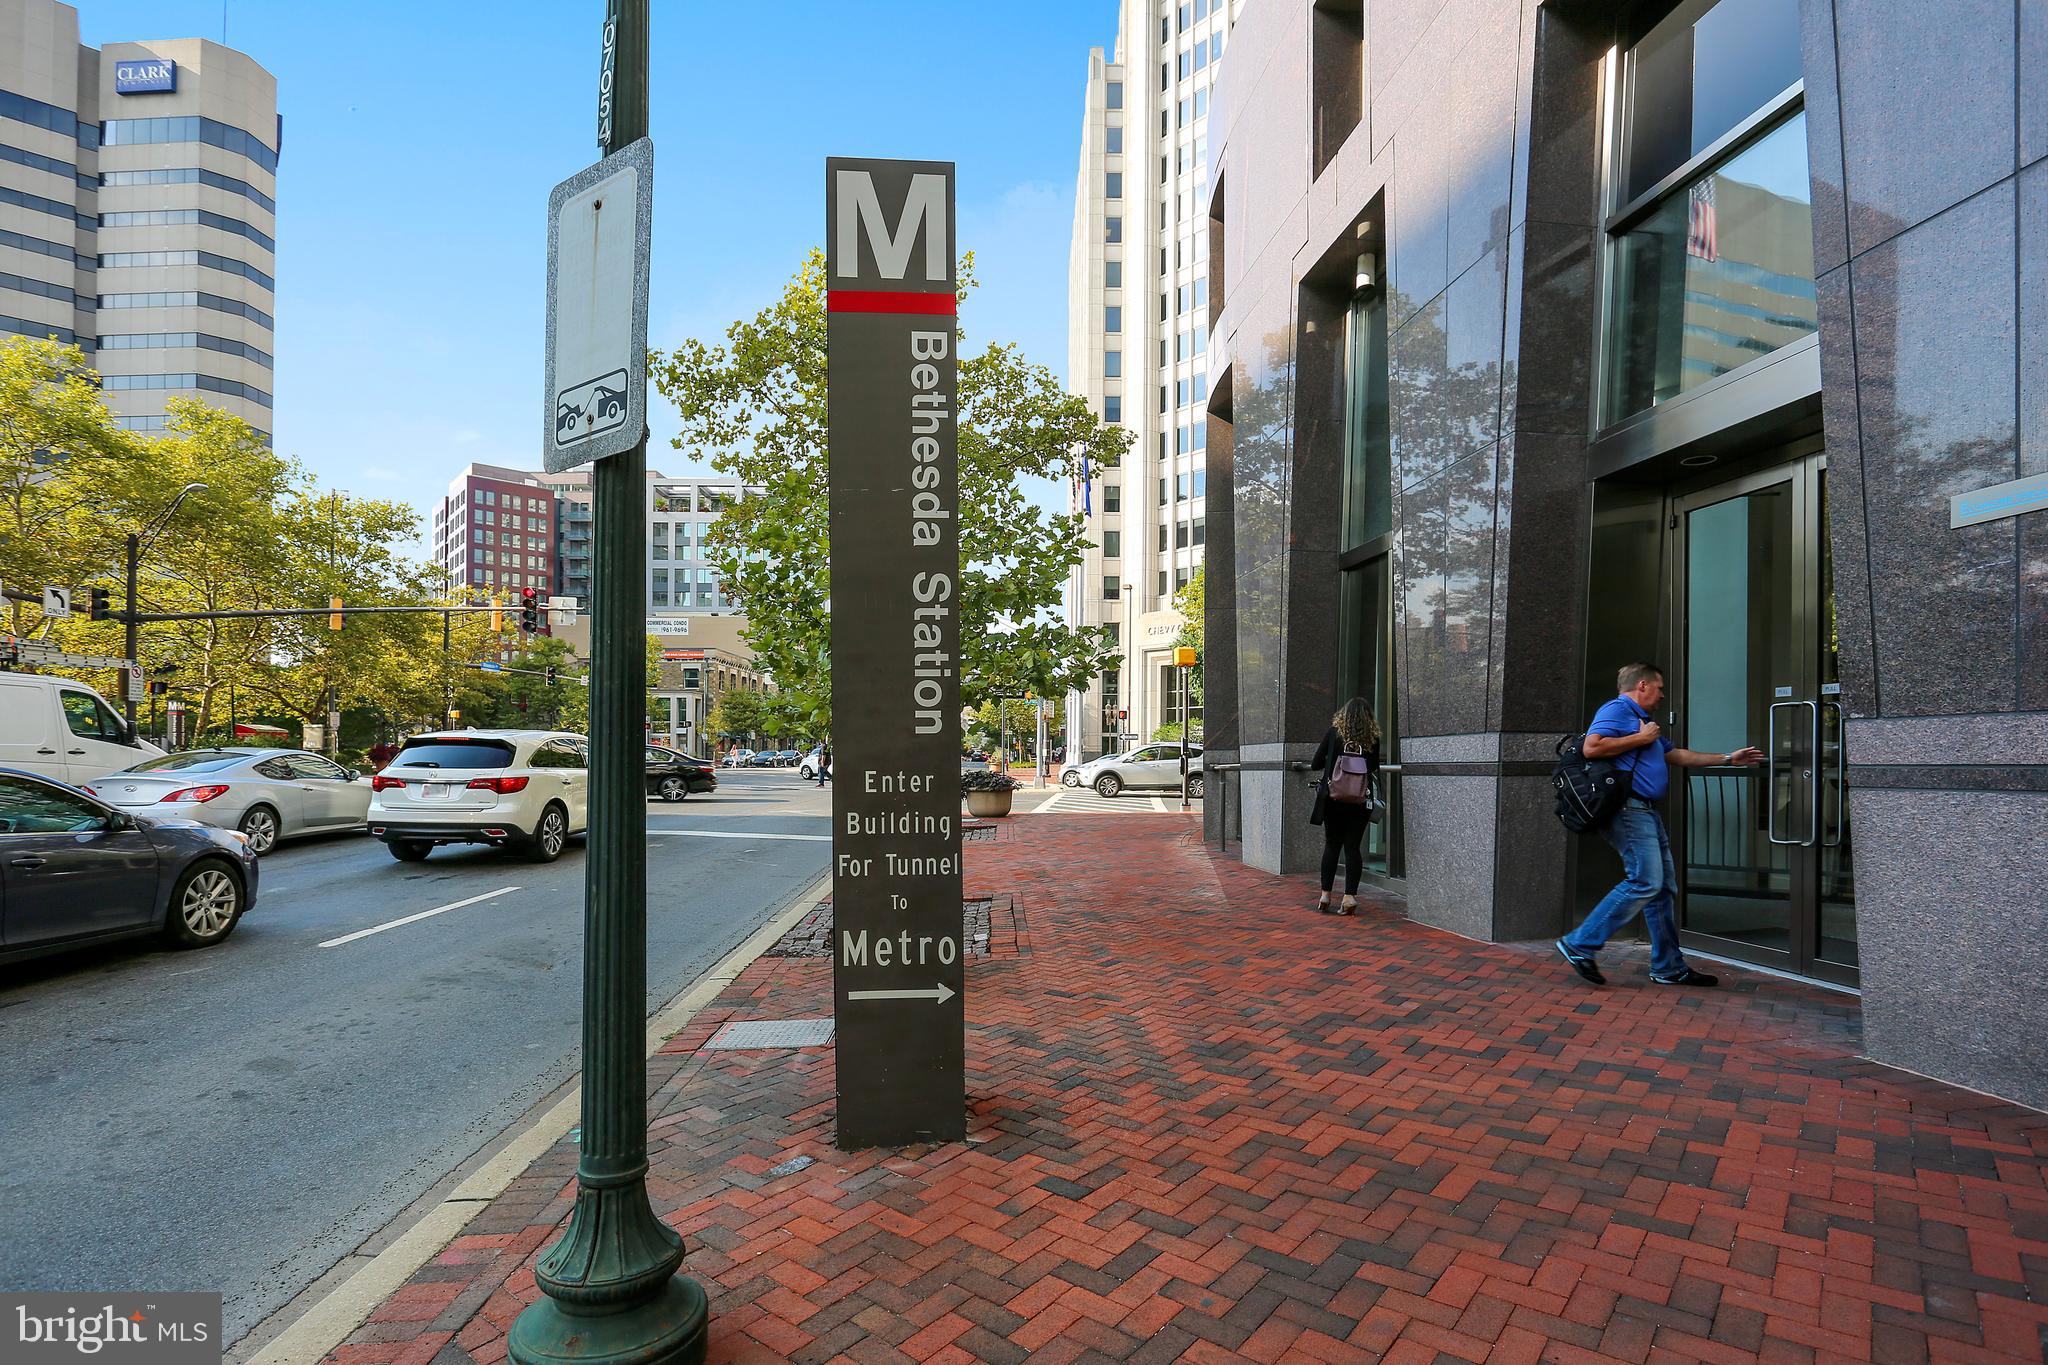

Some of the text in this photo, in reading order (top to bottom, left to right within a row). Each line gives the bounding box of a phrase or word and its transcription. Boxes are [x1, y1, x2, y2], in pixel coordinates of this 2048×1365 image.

[117, 65, 171, 80] CLARK
[600, 22, 615, 142] 07054
[836, 169, 947, 281] M
[910, 330, 951, 735] Bethesda Station
[47, 607, 66, 616] ONLY
[1148, 625, 1175, 635] CHEVY
[865, 770, 934, 793] Enter
[847, 811, 951, 841] Building
[838, 852, 959, 877] For Tunnel
[891, 894, 908, 910] To
[842, 929, 957, 967] Metro
